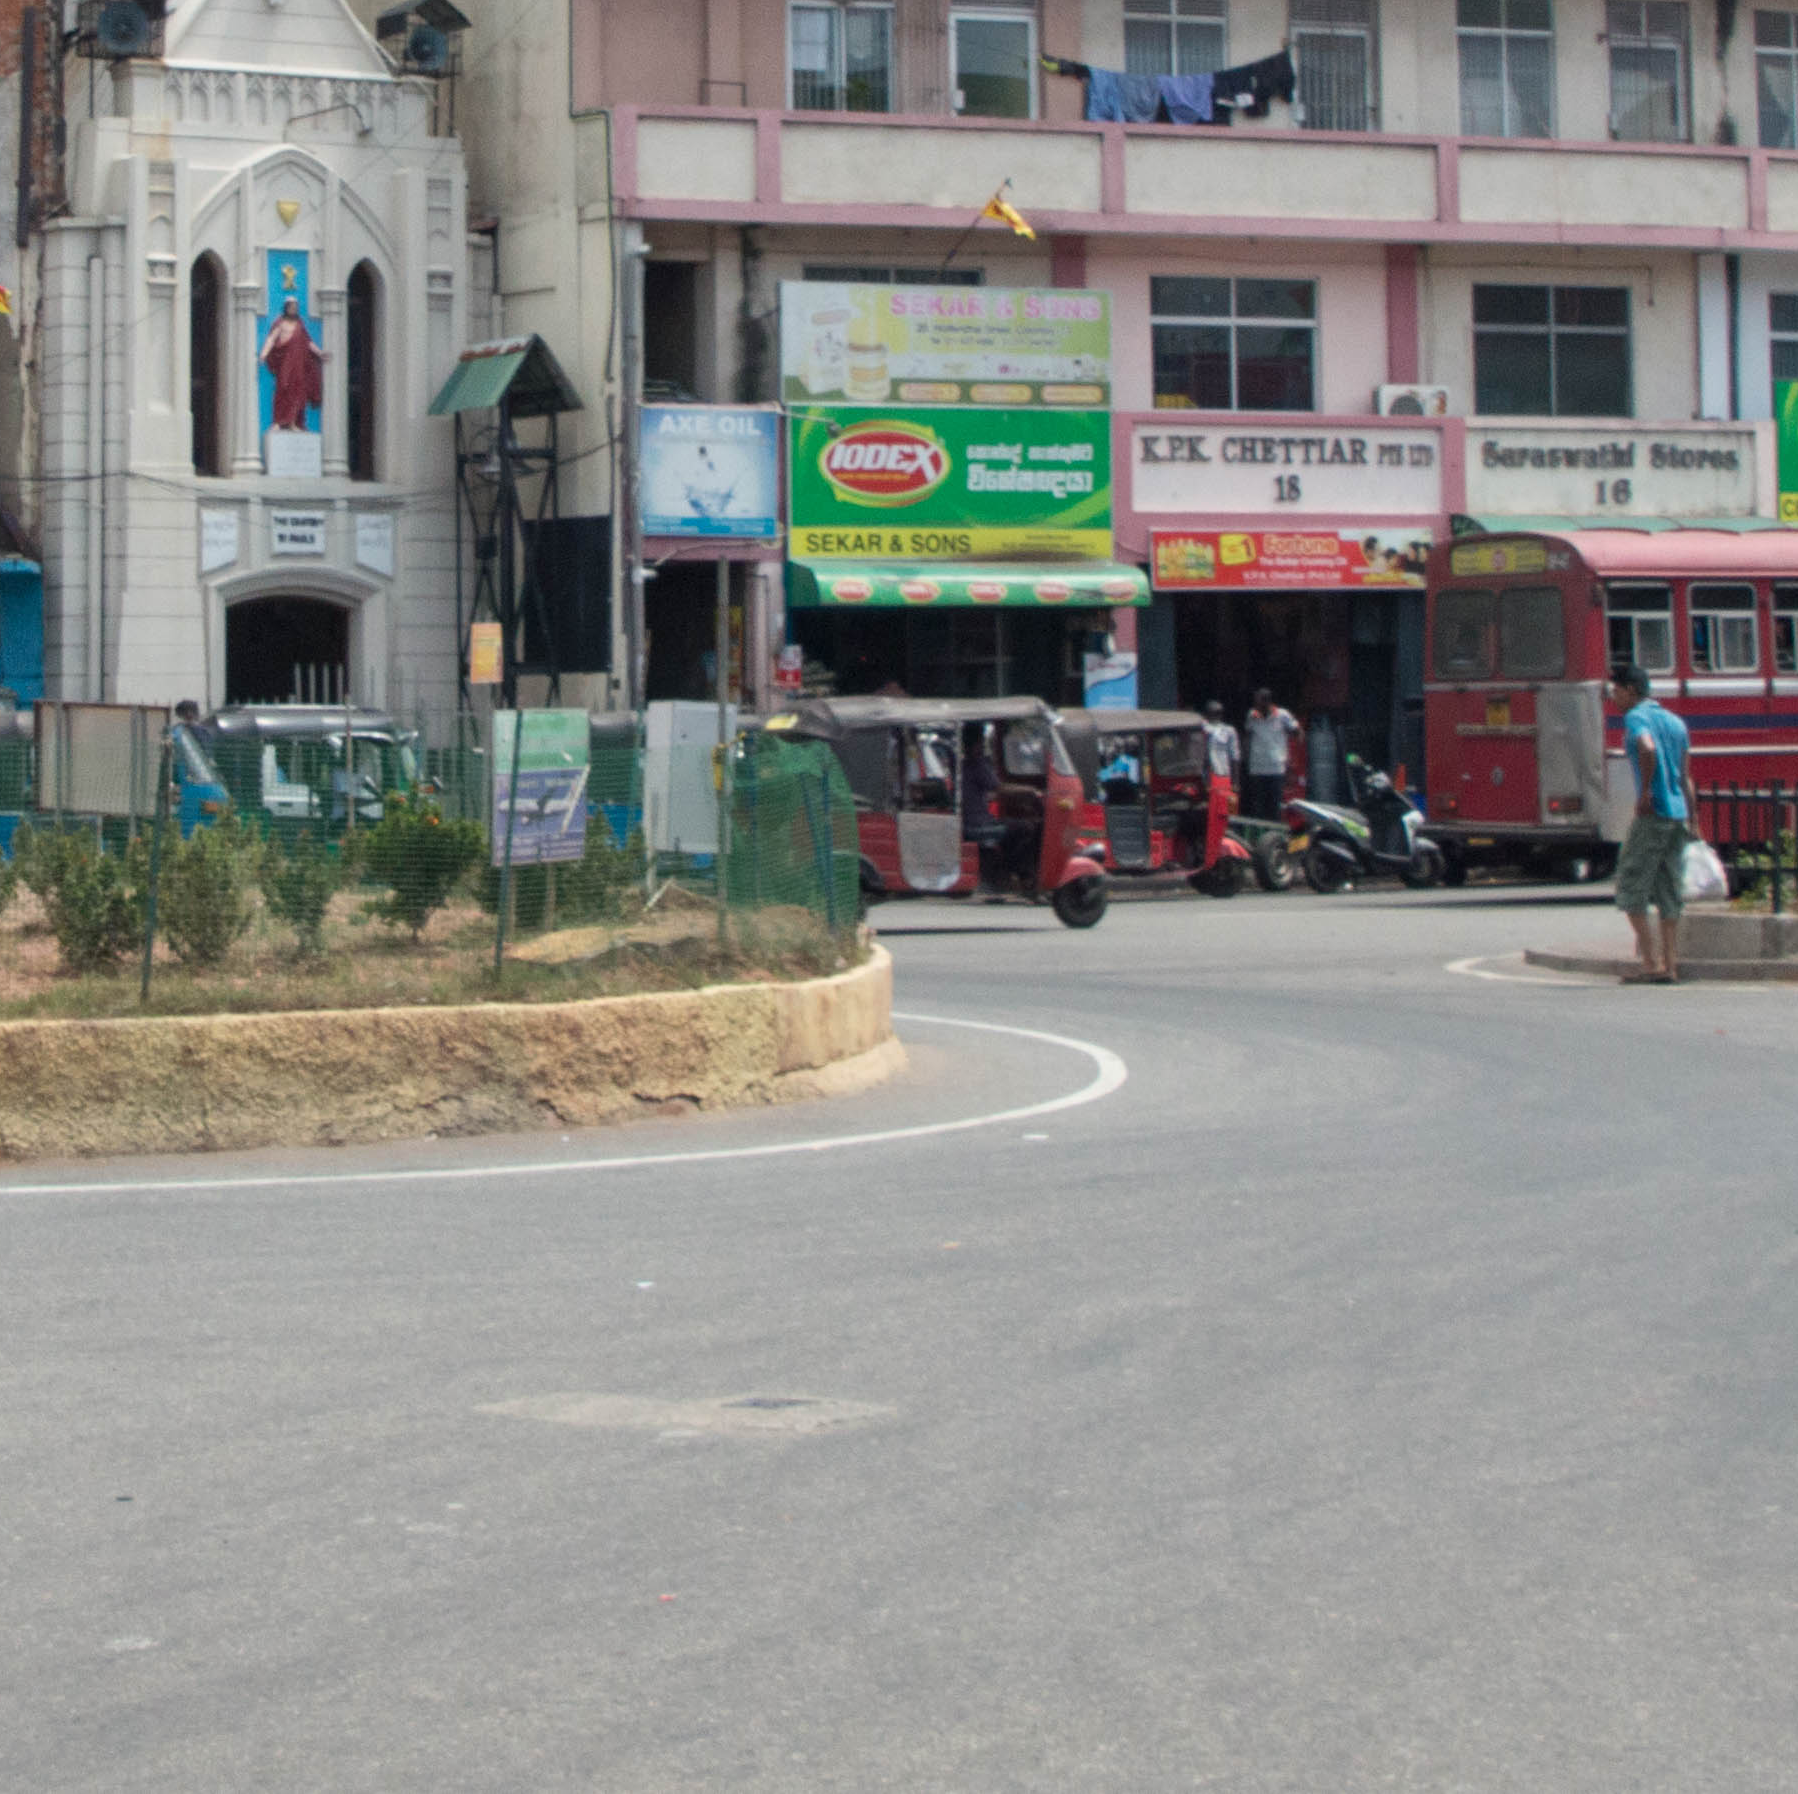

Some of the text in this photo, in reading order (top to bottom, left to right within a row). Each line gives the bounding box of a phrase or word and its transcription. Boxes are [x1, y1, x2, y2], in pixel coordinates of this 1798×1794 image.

[890, 294, 1101, 320] SEKAR & SONS
[659, 415, 762, 436] AXE OIL
[1221, 436, 1369, 464] CHETTIAR
[1650, 443, 1740, 470] Stores
[831, 444, 940, 484] IODEX
[1274, 475, 1301, 503] 18
[1596, 479, 1632, 505] 16
[806, 534, 971, 553] SEKAR & SONS
[1262, 534, 1339, 555] Fortune
